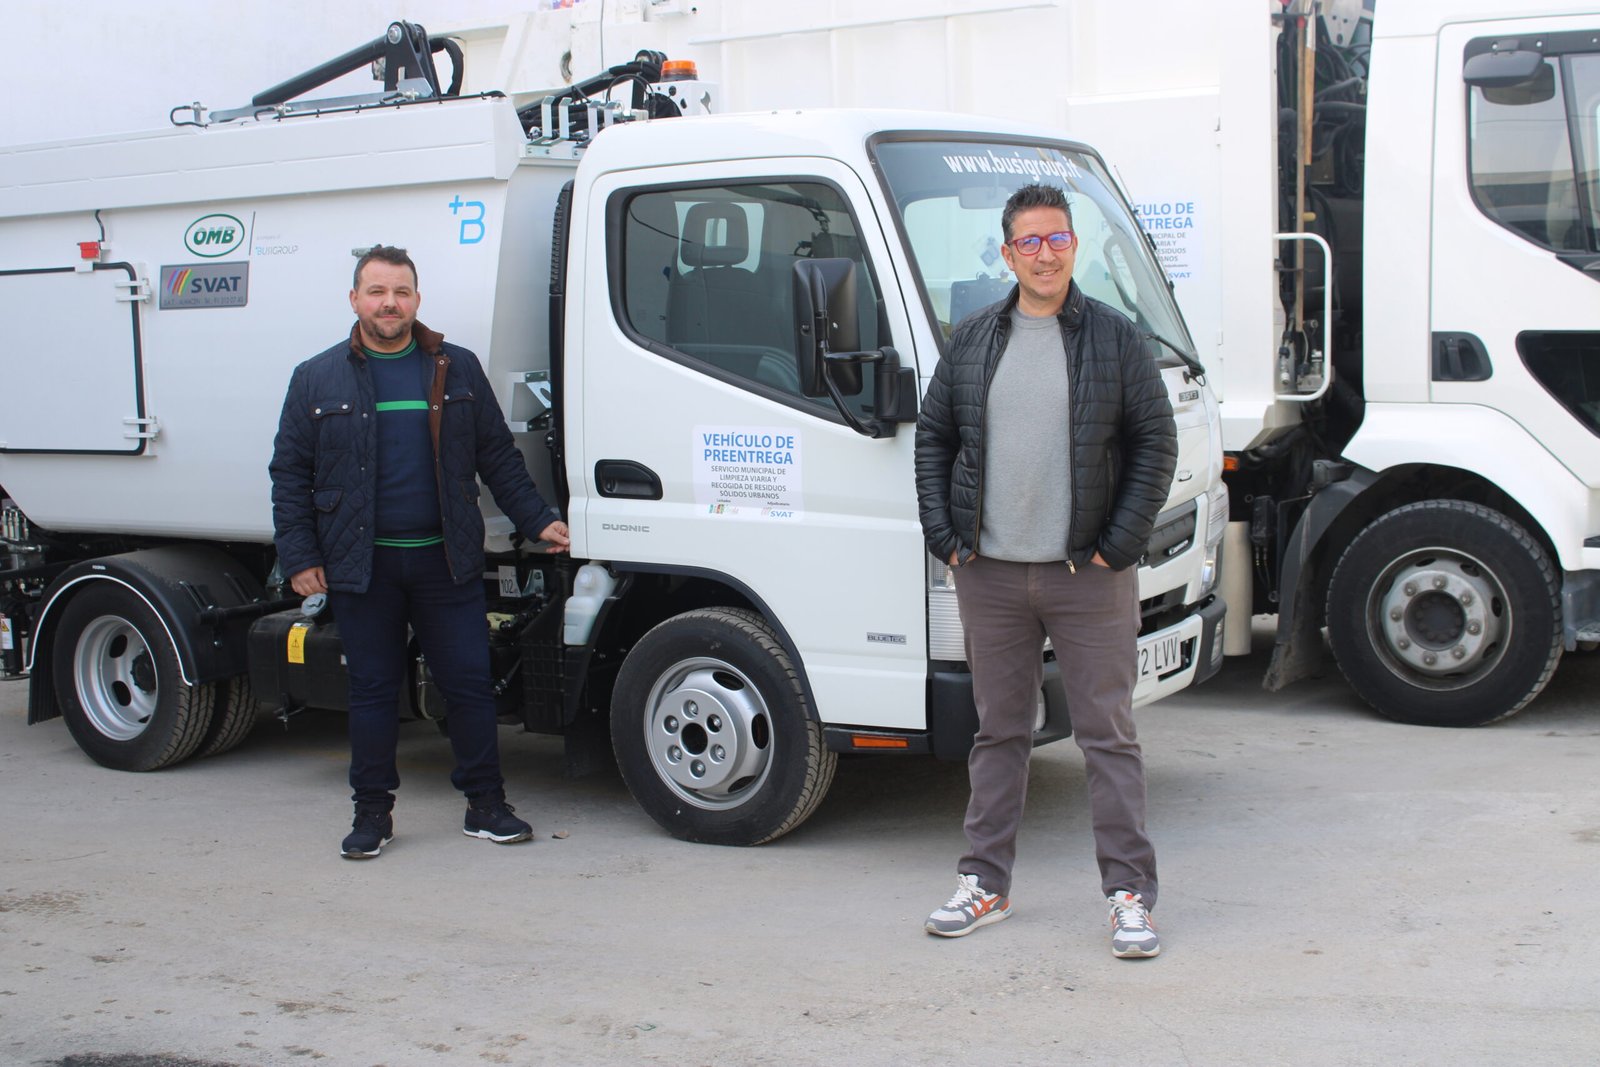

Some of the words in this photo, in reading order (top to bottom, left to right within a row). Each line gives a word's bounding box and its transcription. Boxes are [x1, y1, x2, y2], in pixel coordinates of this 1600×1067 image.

[942, 150, 1083, 183] www.busigroup.it
[1175, 202, 1194, 215] DE
[193, 226, 235, 245] OMB
[191, 276, 241, 294] SVAT
[703, 432, 772, 448] VEHÍCULO
[775, 435, 795, 449] DE
[704, 448, 793, 465] PREENTREGA
[711, 465, 740, 473] SERVICIO
[740, 466, 776, 475] MUNICIPAL
[719, 474, 749, 482] LIMPIEZA
[750, 475, 772, 483] VIARIA
[711, 482, 744, 490] RECOGIDA
[754, 484, 787, 492] RESIDUOS
[748, 492, 780, 500] URBANOS
[770, 510, 794, 518] SVAT
[602, 523, 650, 533] DUONIC
